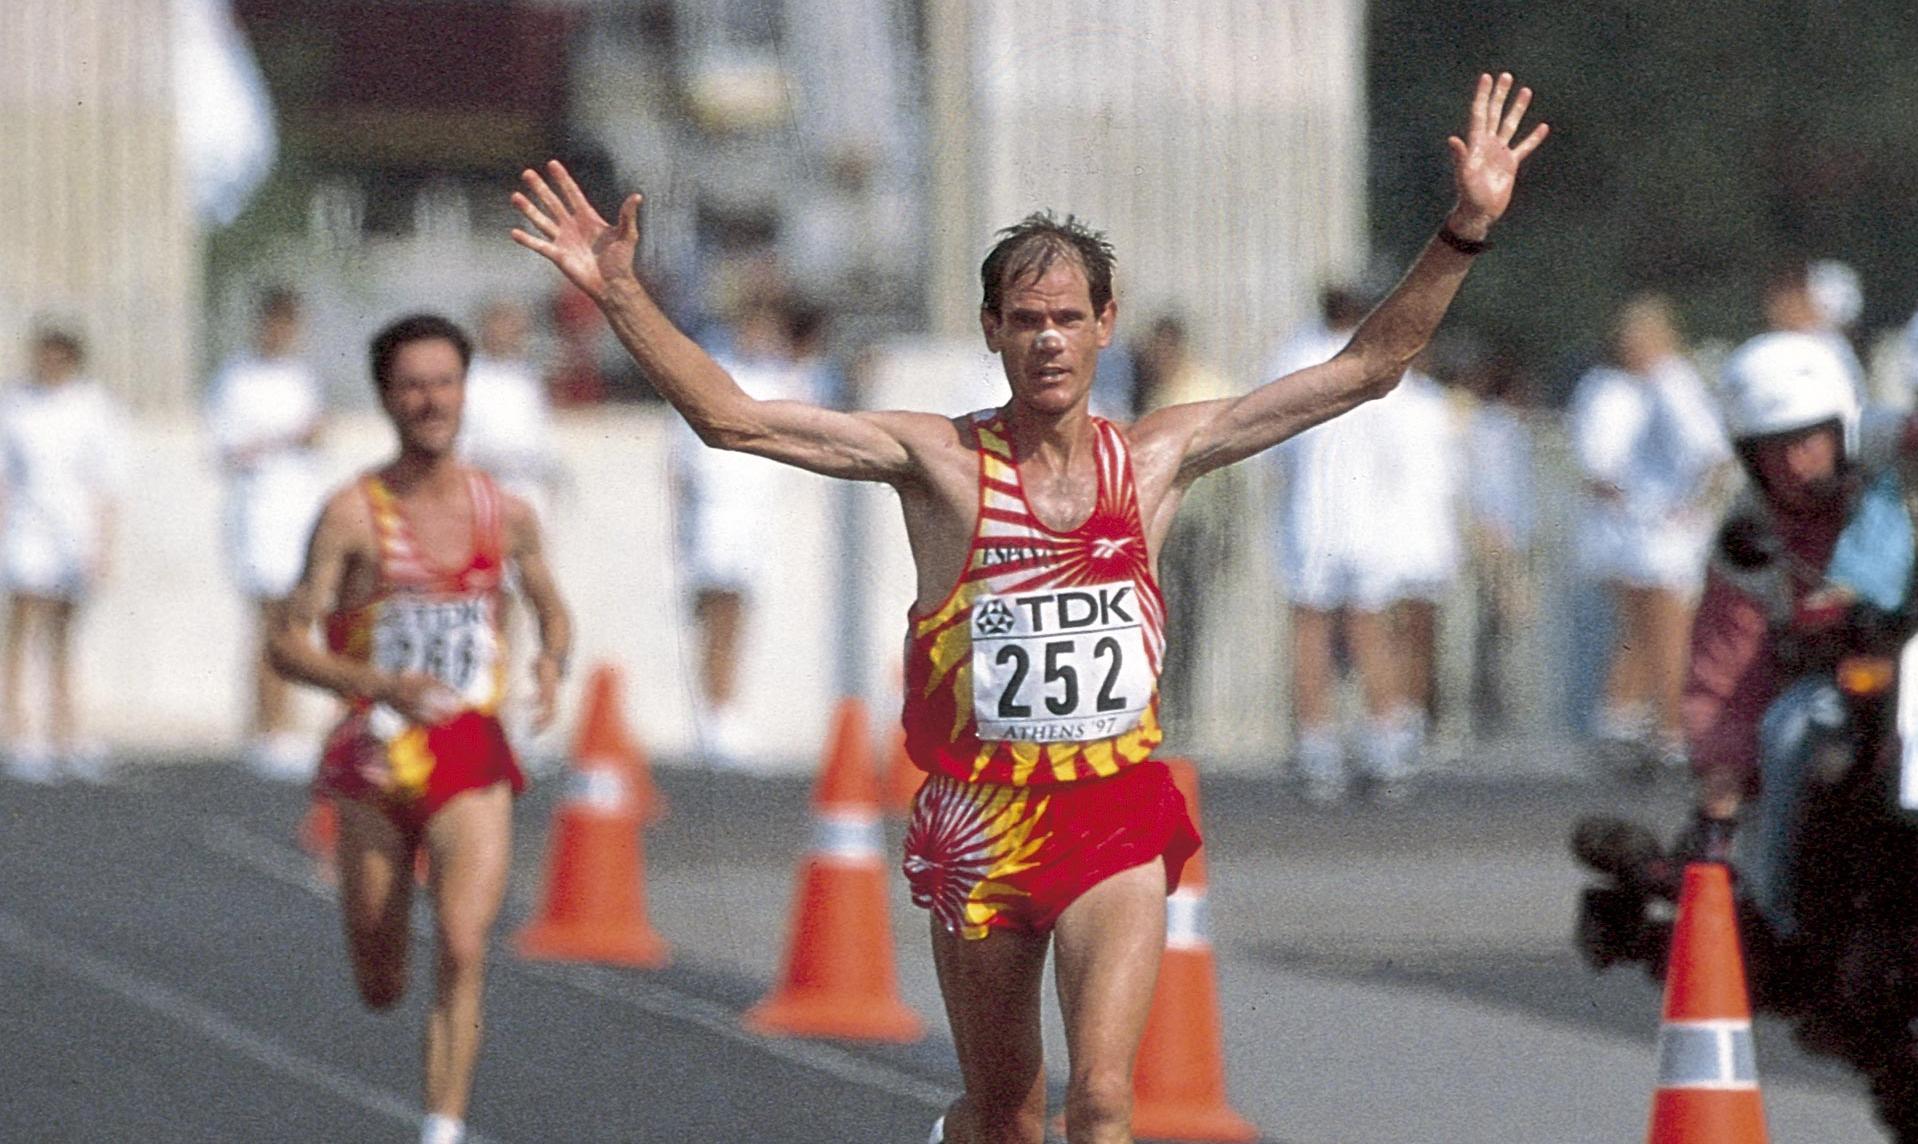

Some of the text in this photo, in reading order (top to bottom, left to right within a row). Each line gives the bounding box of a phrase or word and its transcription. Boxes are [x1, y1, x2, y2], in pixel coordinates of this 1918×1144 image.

[1016, 587, 1134, 632] TDK
[996, 637, 1127, 718] 252
[1002, 718, 1118, 740] ATHENS '97
